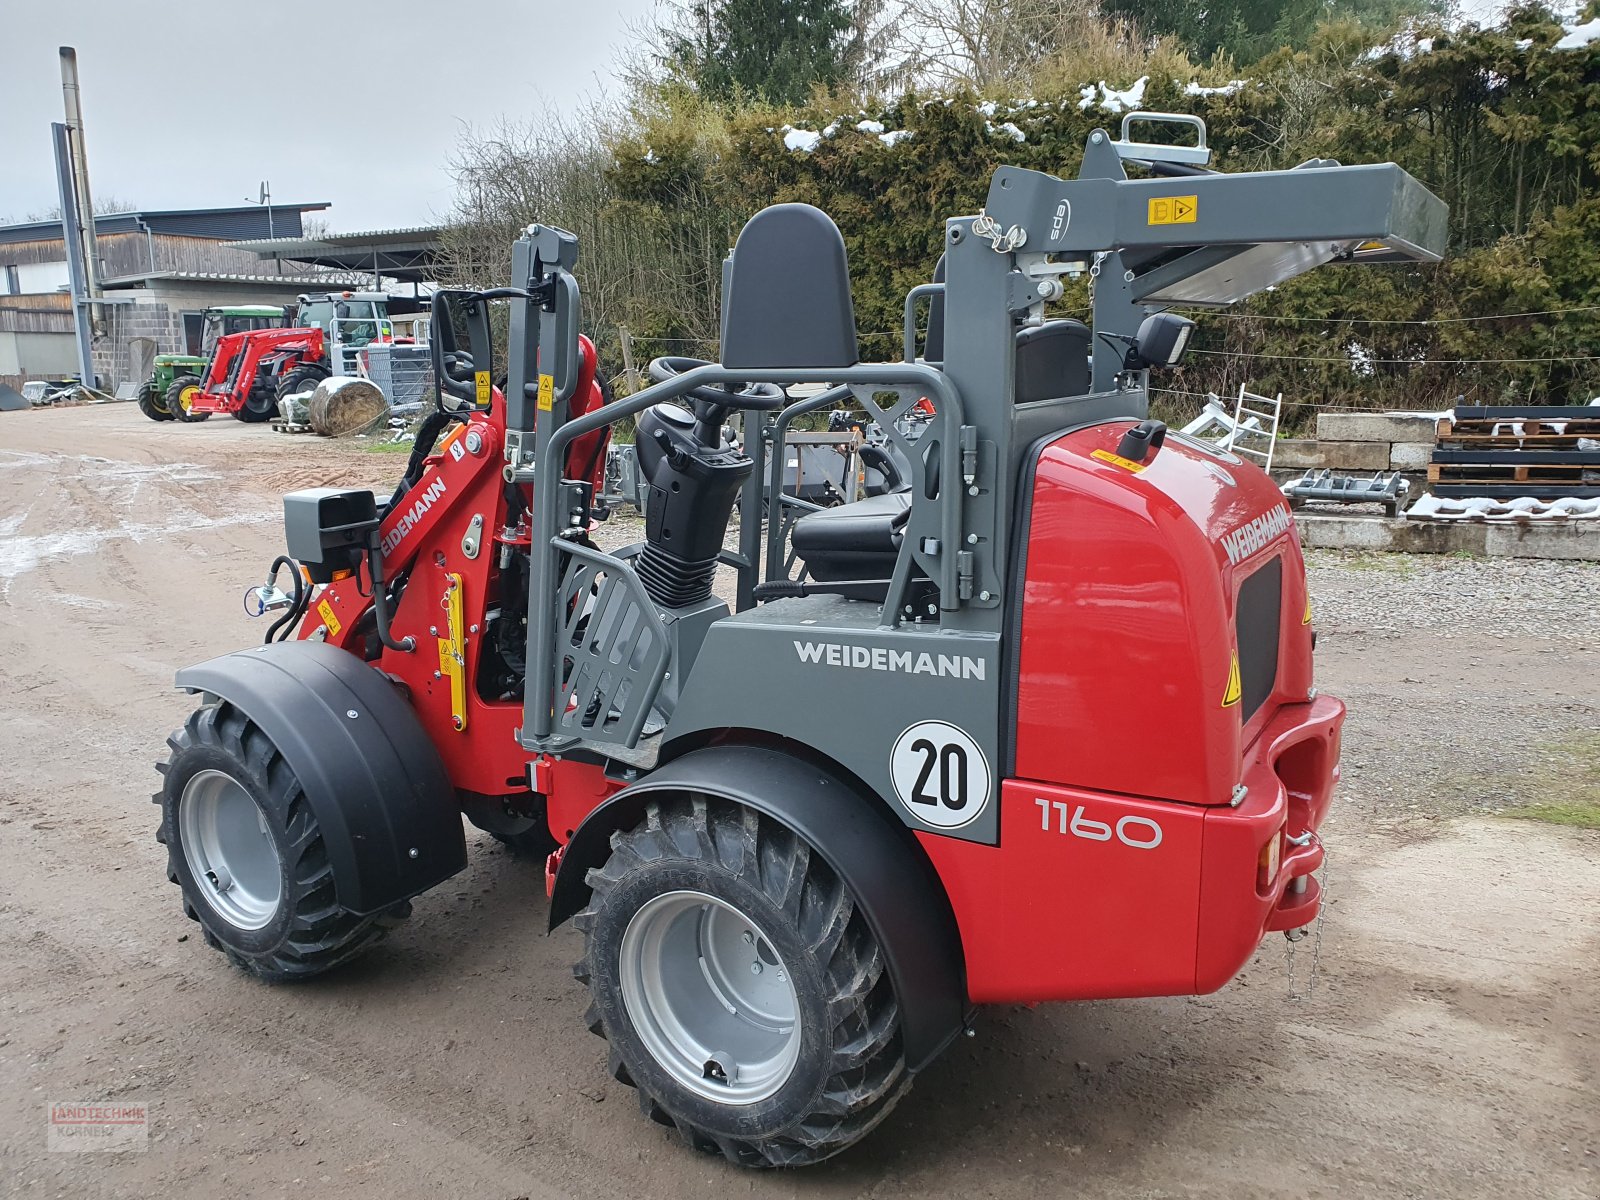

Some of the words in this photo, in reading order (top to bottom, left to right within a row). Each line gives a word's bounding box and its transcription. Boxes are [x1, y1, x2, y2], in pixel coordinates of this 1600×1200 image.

[1050, 204, 1066, 240] eps
[381, 476, 447, 558] EIDEMANN
[1220, 502, 1290, 566] WEIDEMANN
[793, 640, 986, 681] WEIDEMANN
[910, 738, 968, 811] 20
[1034, 797, 1163, 849] 1160
